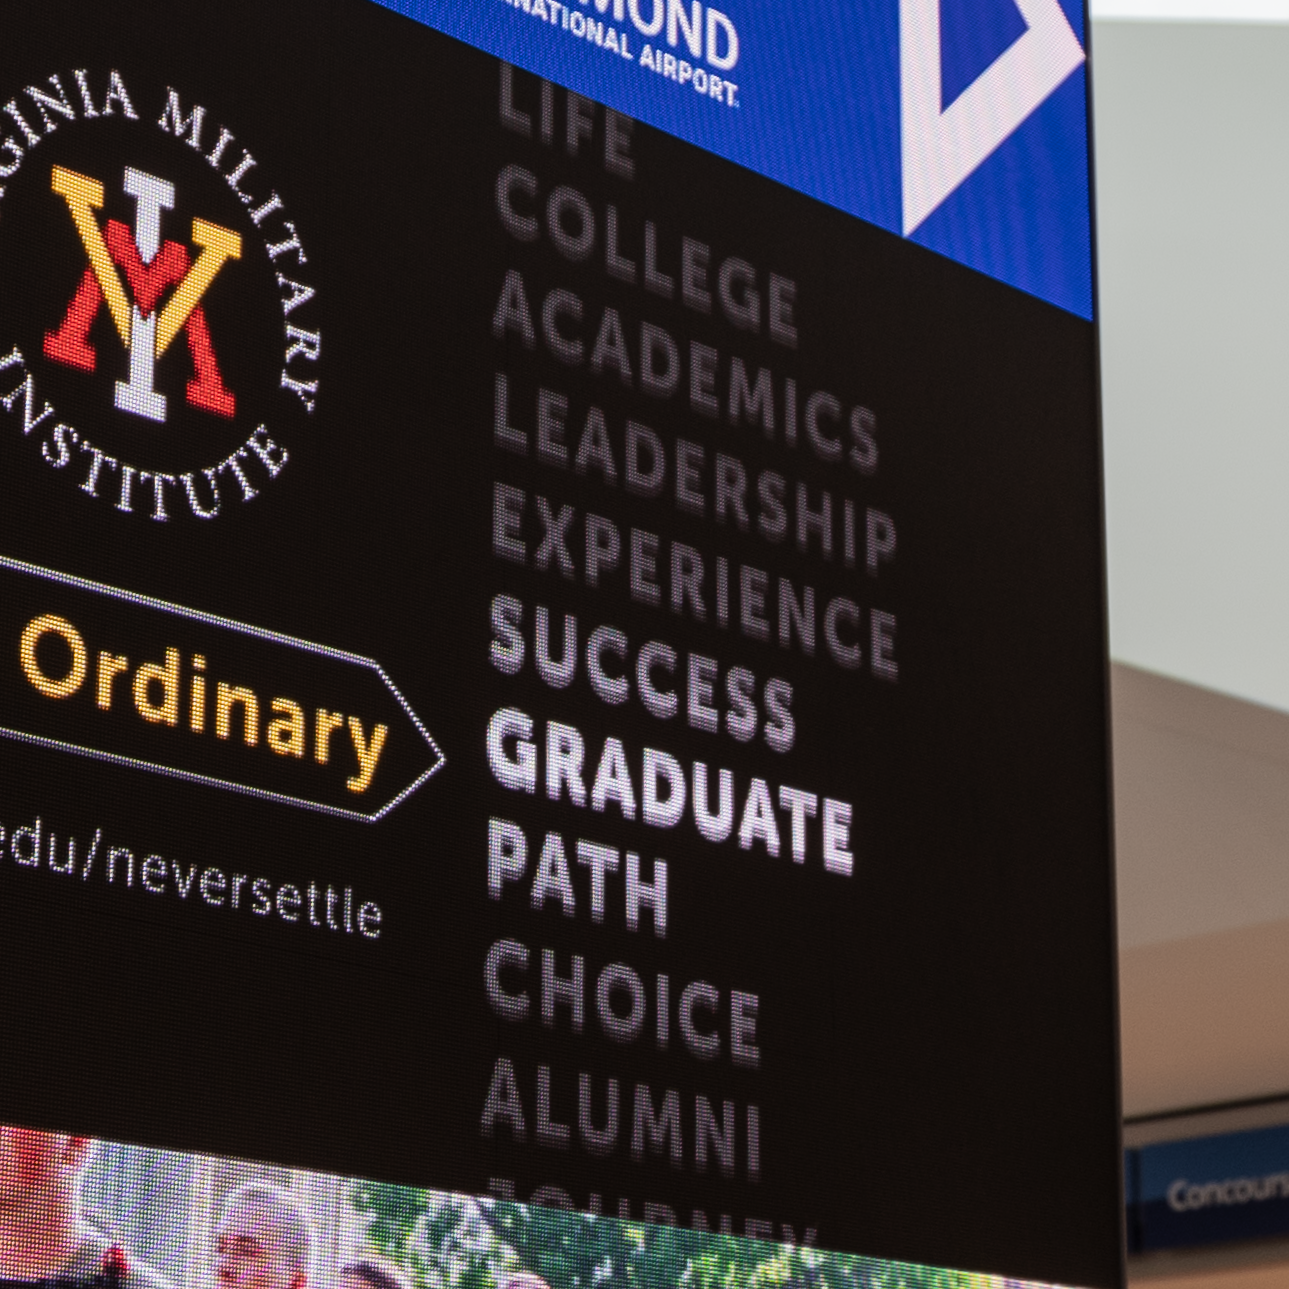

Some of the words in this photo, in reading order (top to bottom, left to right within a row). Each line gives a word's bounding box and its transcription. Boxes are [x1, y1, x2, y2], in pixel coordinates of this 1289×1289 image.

[499, 62, 634, 179] LIFE
[157, 86, 321, 413] MILITARY
[496, 163, 797, 348] COLLEGE
[492, 269, 878, 475] ACADEMICS
[494, 372, 897, 576] LEADERSHIP
[492, 481, 898, 683] EXPERIENCE
[20, 613, 389, 794] Ordinary
[488, 593, 795, 752] SUCCESS
[486, 707, 854, 877] GRADUATE
[487, 816, 668, 939] PATH
[483, 938, 761, 1069] CHOICE
[480, 1056, 760, 1183] ALUMNI
